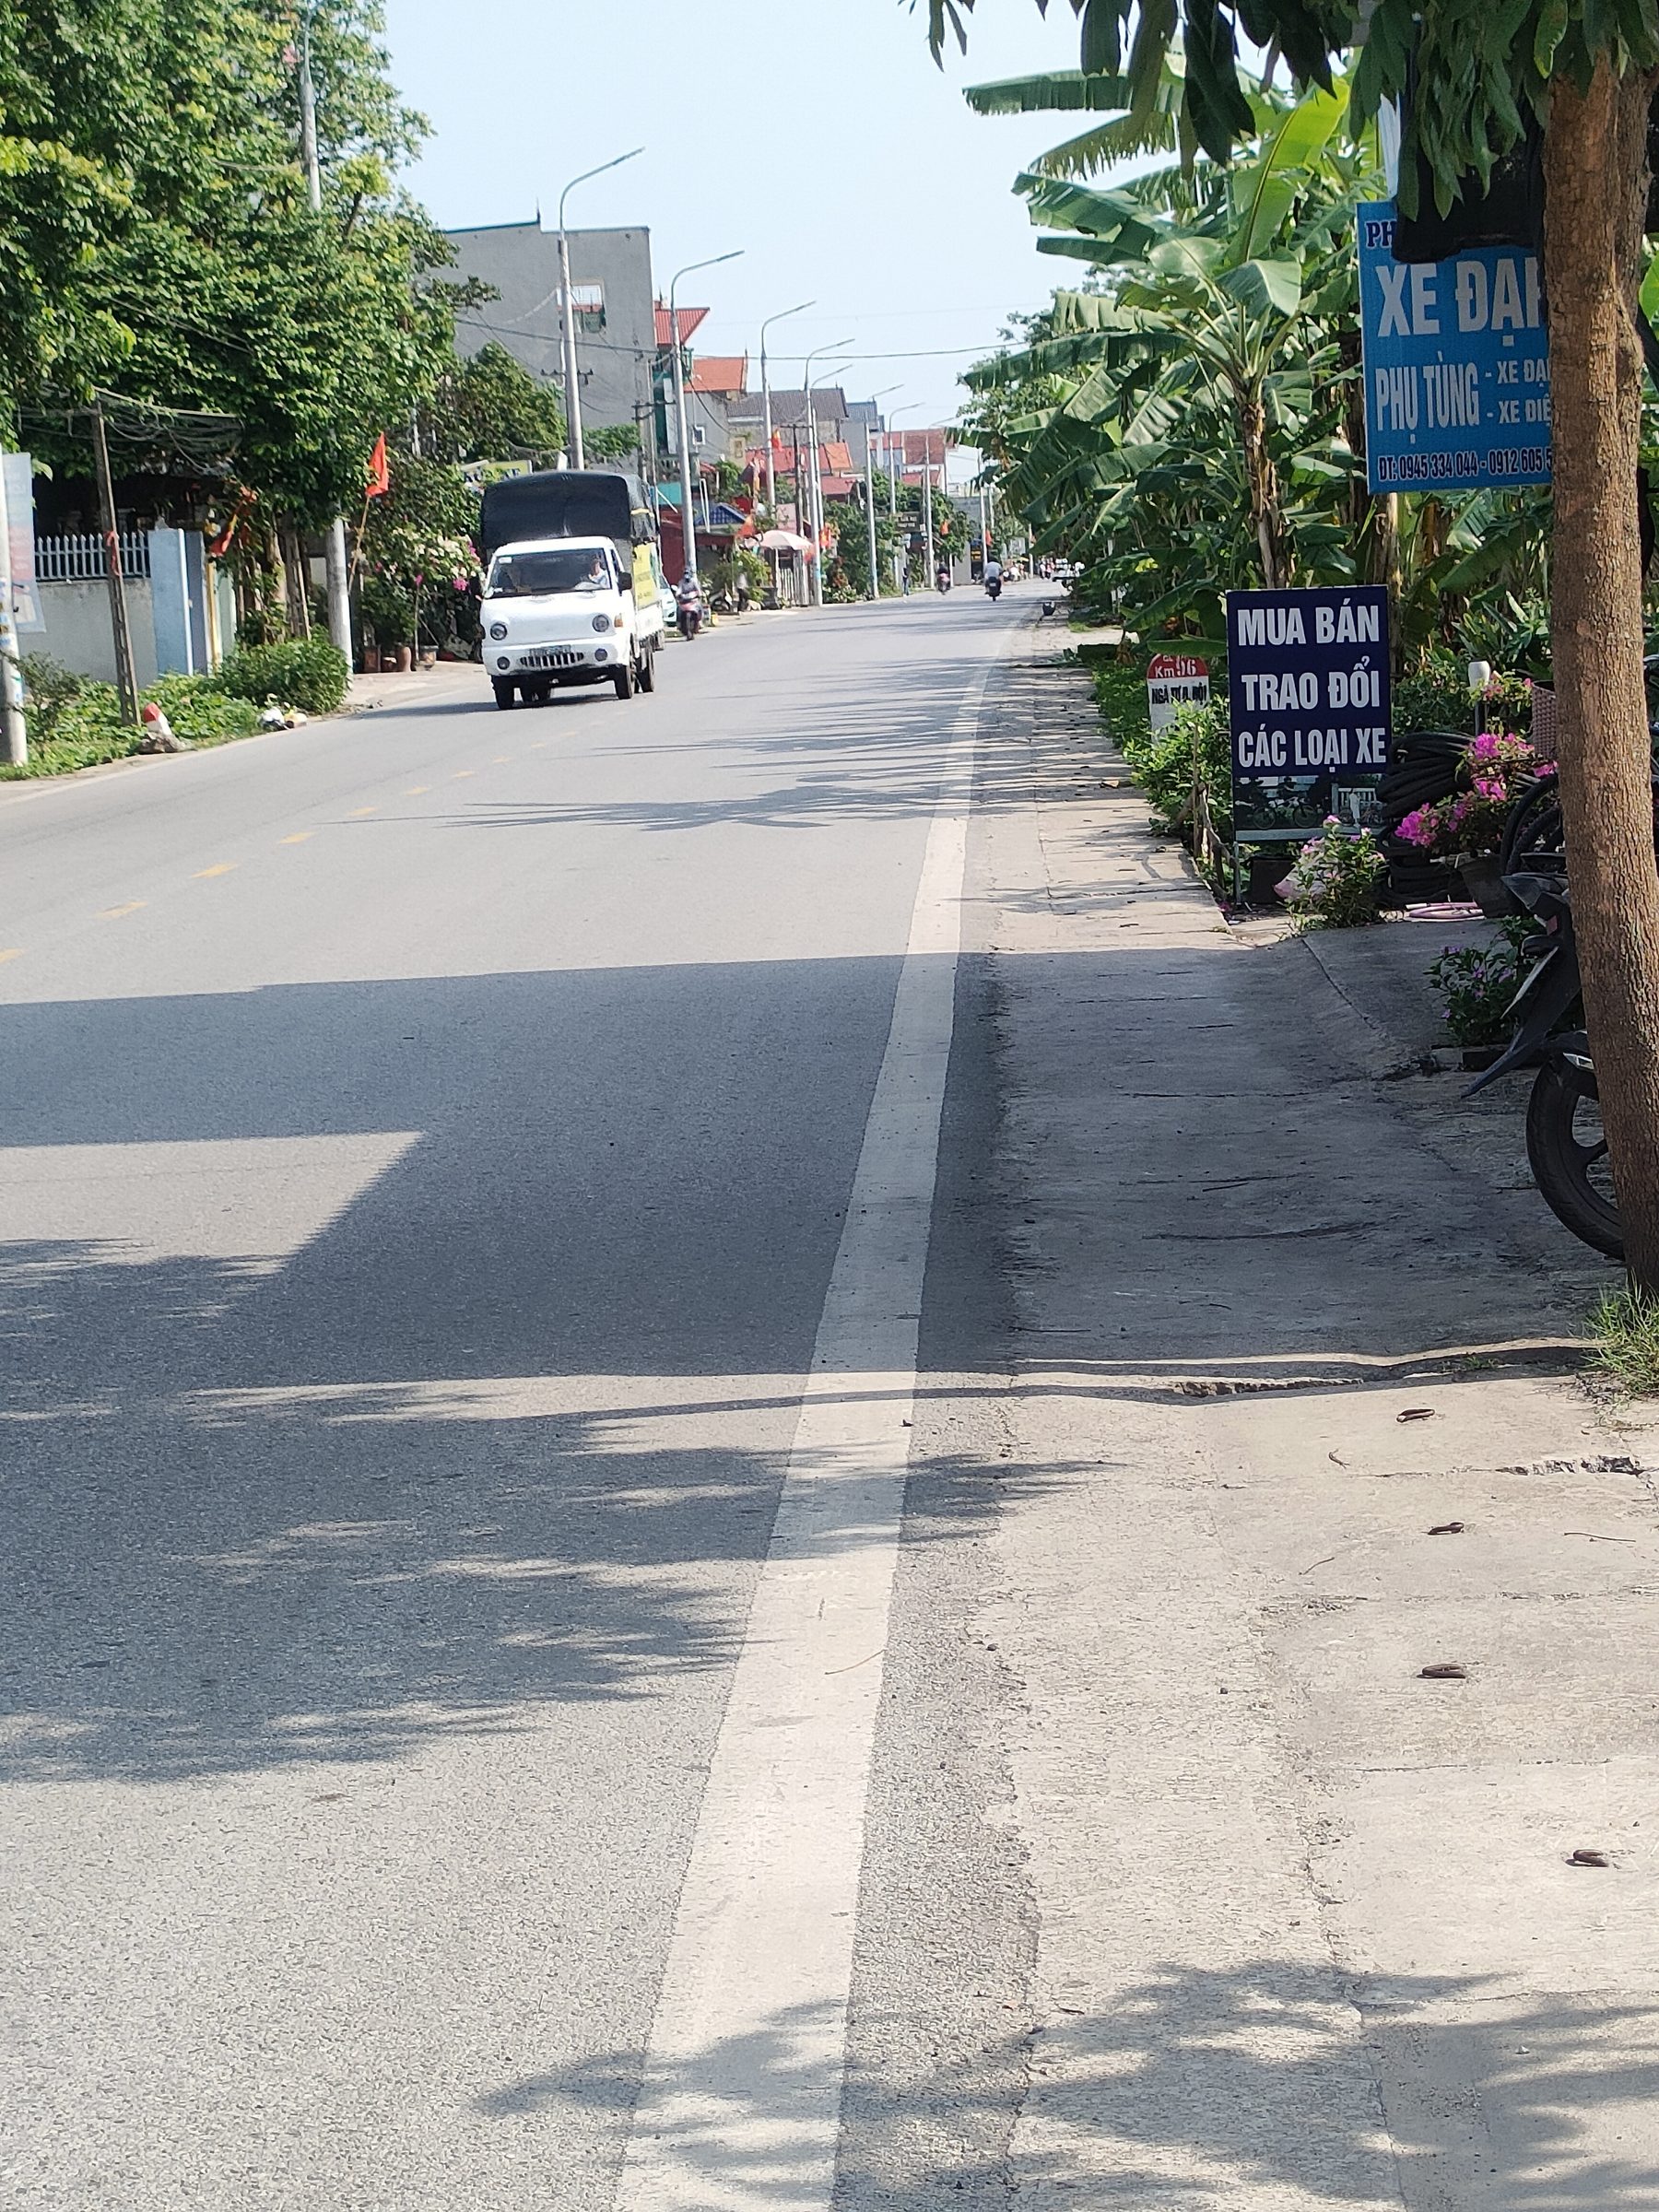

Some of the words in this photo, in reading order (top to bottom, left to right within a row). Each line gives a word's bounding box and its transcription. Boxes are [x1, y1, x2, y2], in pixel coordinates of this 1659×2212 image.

[1375, 263, 1441, 337] XE
[1375, 366, 1418, 444] PHỤ
[1422, 350, 1480, 429] TÙNG
[1497, 360, 1519, 384] XE
[1524, 359, 1552, 387] ĐẠ
[1498, 400, 1521, 424] XE
[1525, 394, 1553, 427] ĐIỆ
[1379, 455, 1397, 482] ĐT:
[1399, 453, 1429, 479] 0945
[1430, 452, 1453, 477] 334
[1455, 451, 1477, 477] 044
[1488, 448, 1518, 476] 0912
[1521, 447, 1543, 473] 605
[1238, 608, 1306, 646] MUA
[1315, 598, 1380, 644] BÁN
[1241, 672, 1318, 712] TRAO
[1327, 655, 1381, 709] ĐỔI
[1238, 724, 1287, 768] CÁC
[1294, 728, 1348, 773] LOẠI
[1355, 727, 1386, 764] XE
